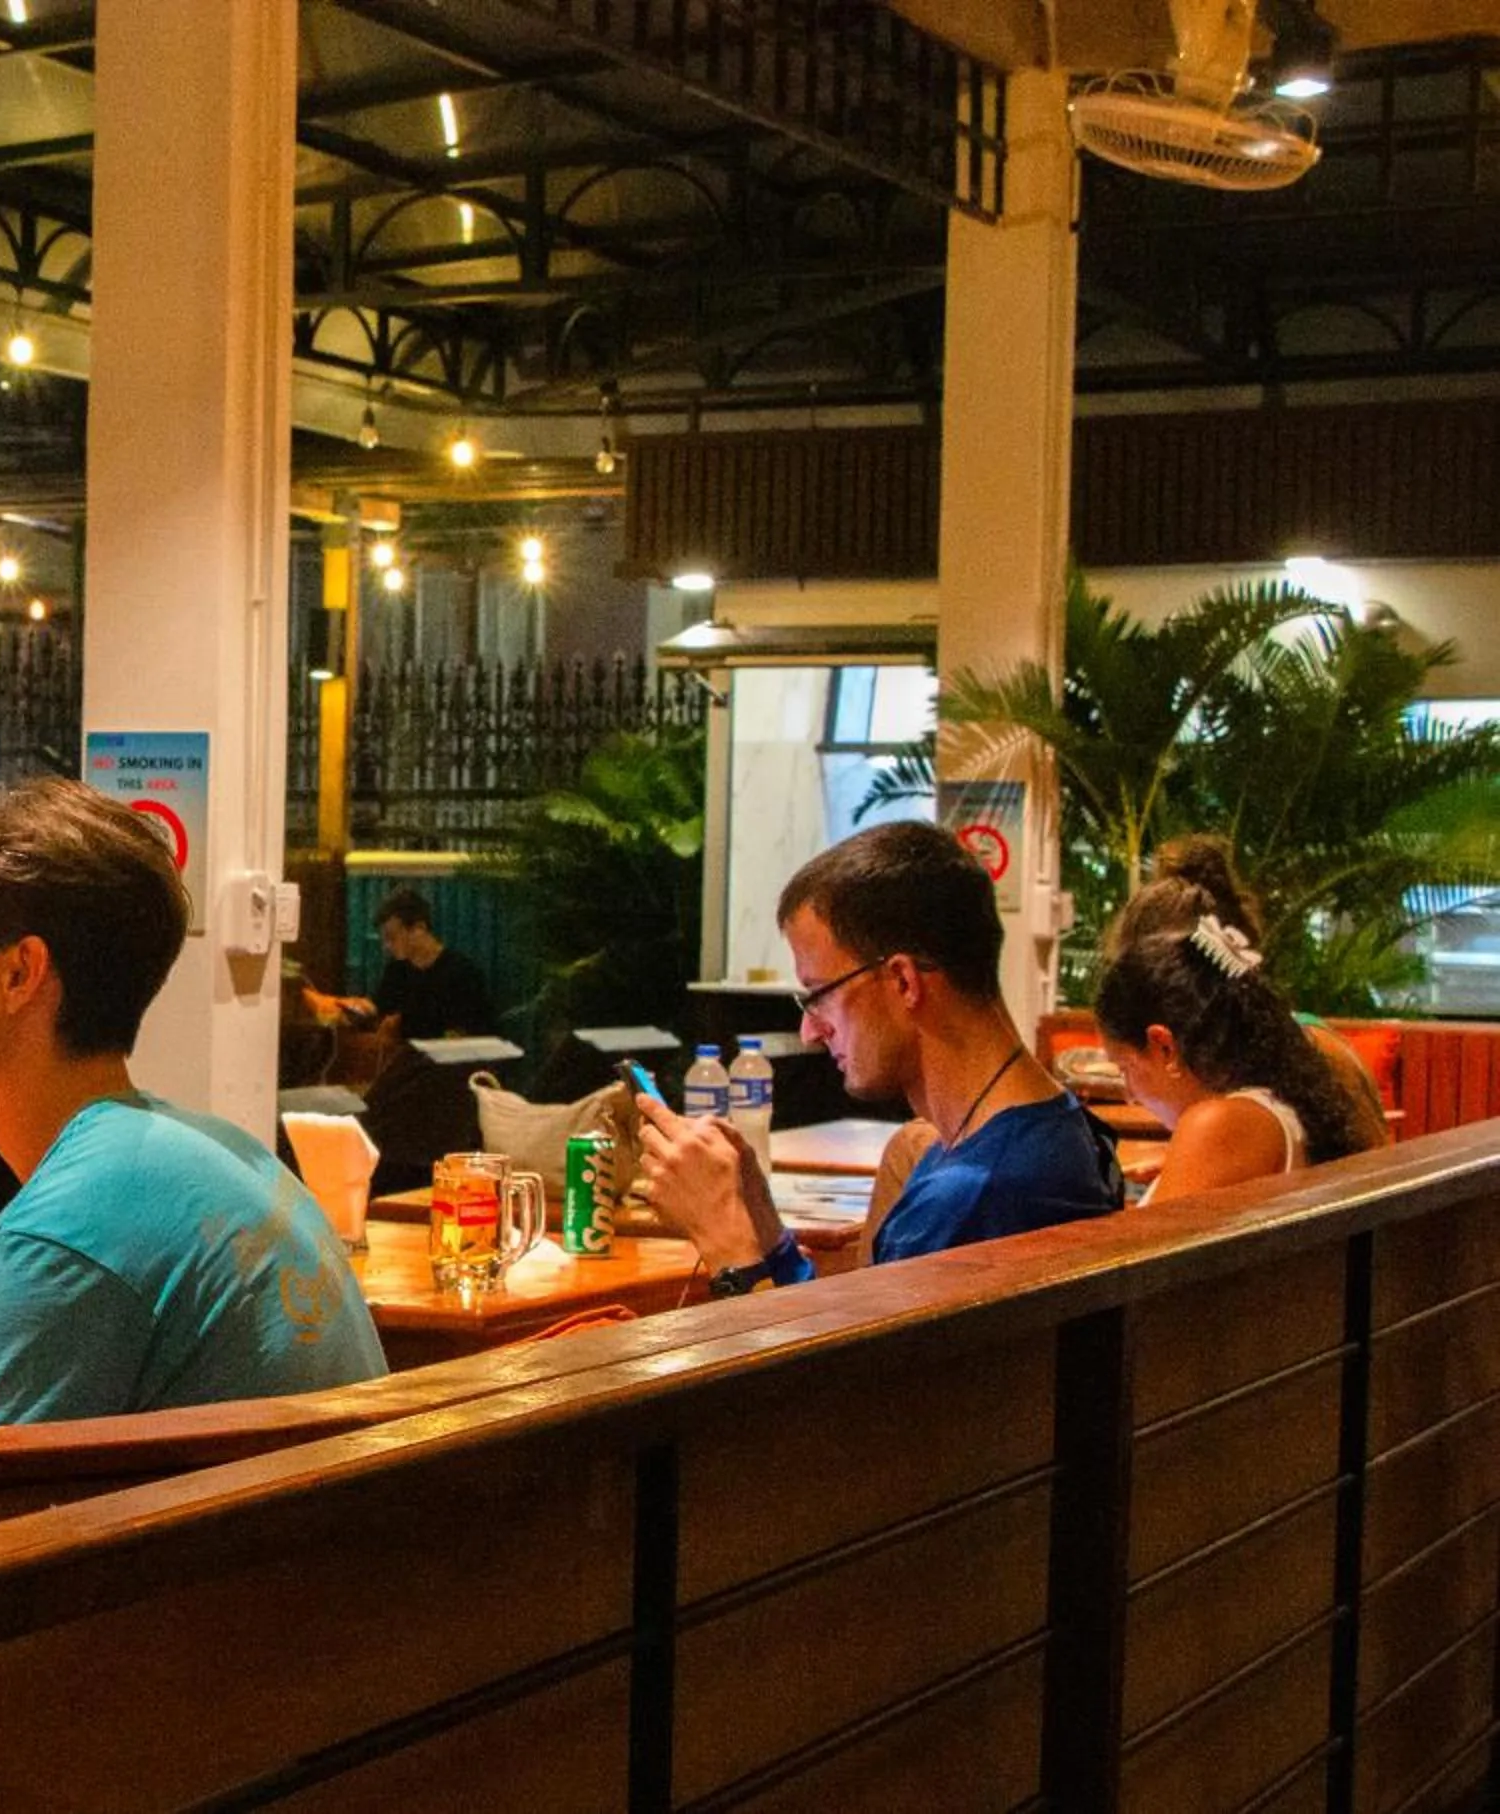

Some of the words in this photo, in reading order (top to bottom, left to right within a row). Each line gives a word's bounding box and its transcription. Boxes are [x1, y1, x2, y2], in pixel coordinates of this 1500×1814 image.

[118, 757, 184, 770] SMOKING
[187, 757, 203, 770] IN
[117, 779, 143, 790] THIS
